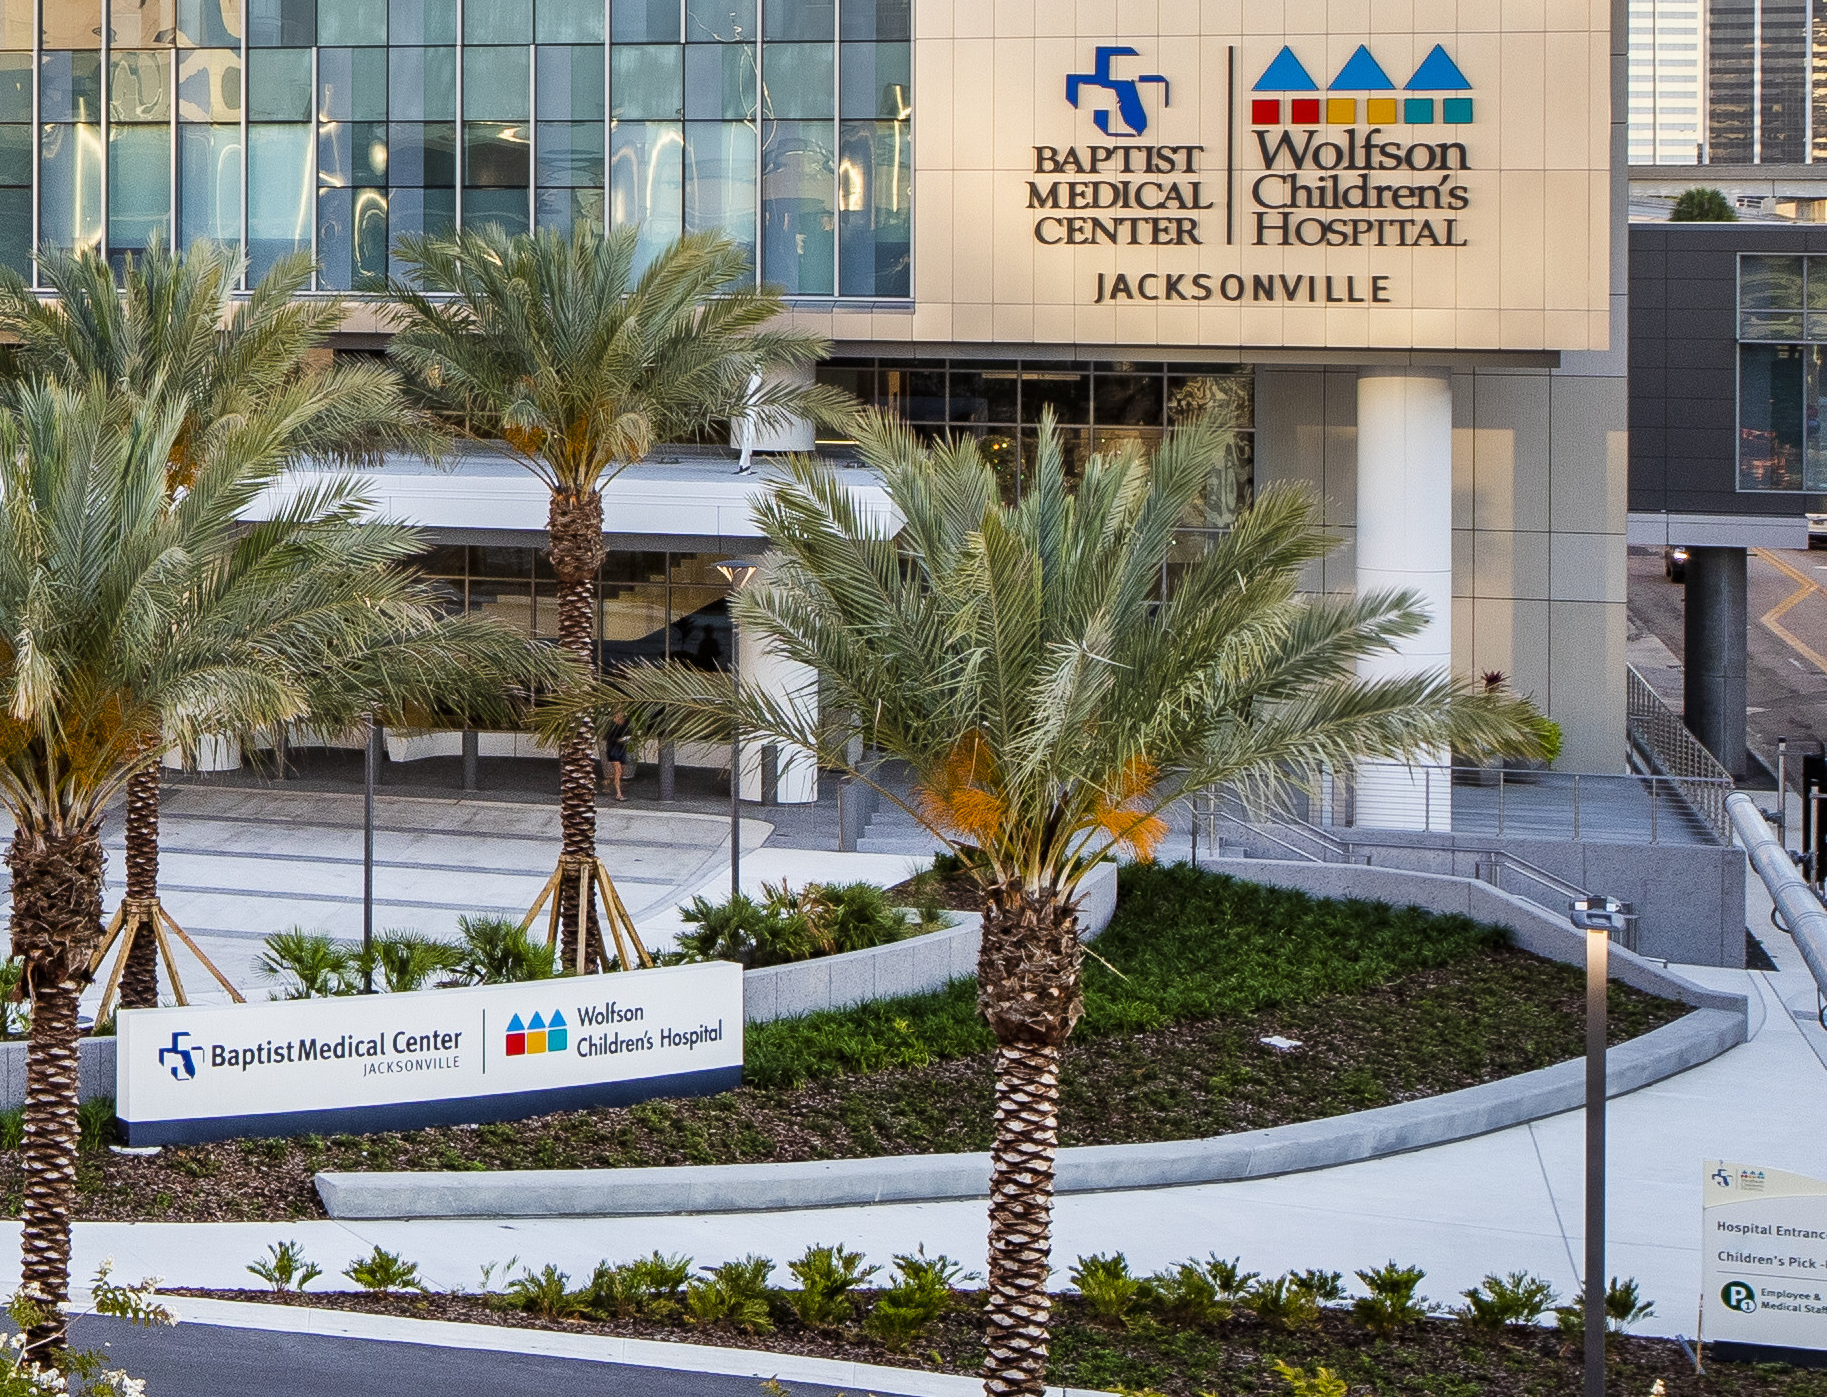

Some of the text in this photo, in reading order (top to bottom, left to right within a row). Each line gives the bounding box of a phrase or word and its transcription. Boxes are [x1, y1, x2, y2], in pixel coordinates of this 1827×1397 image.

[1032, 145, 1204, 174] BAPTIST
[1251, 128, 1472, 171] Wolfson
[1025, 181, 1214, 210] MEDICAL
[1251, 173, 1469, 211] Children's
[1034, 217, 1203, 246] CENTER
[1251, 212, 1468, 247] HOSPITAL
[1094, 273, 1391, 303] JACKSONVILLE
[576, 1001, 644, 1027] Wolfson
[211, 1030, 462, 1072] Baptist Medical Center
[576, 1018, 723, 1058] Children's Hospital
[363, 1055, 460, 1077] JACKSONVILLE
[1717, 1221, 1827, 1239] Hospital Entranc
[1718, 1251, 1785, 1266] Children's
[1789, 1257, 1816, 1269] Pick
[1730, 1286, 1747, 1306] P
[1761, 1288, 1821, 1301] Employee &
[1761, 1301, 1801, 1312] Medical
